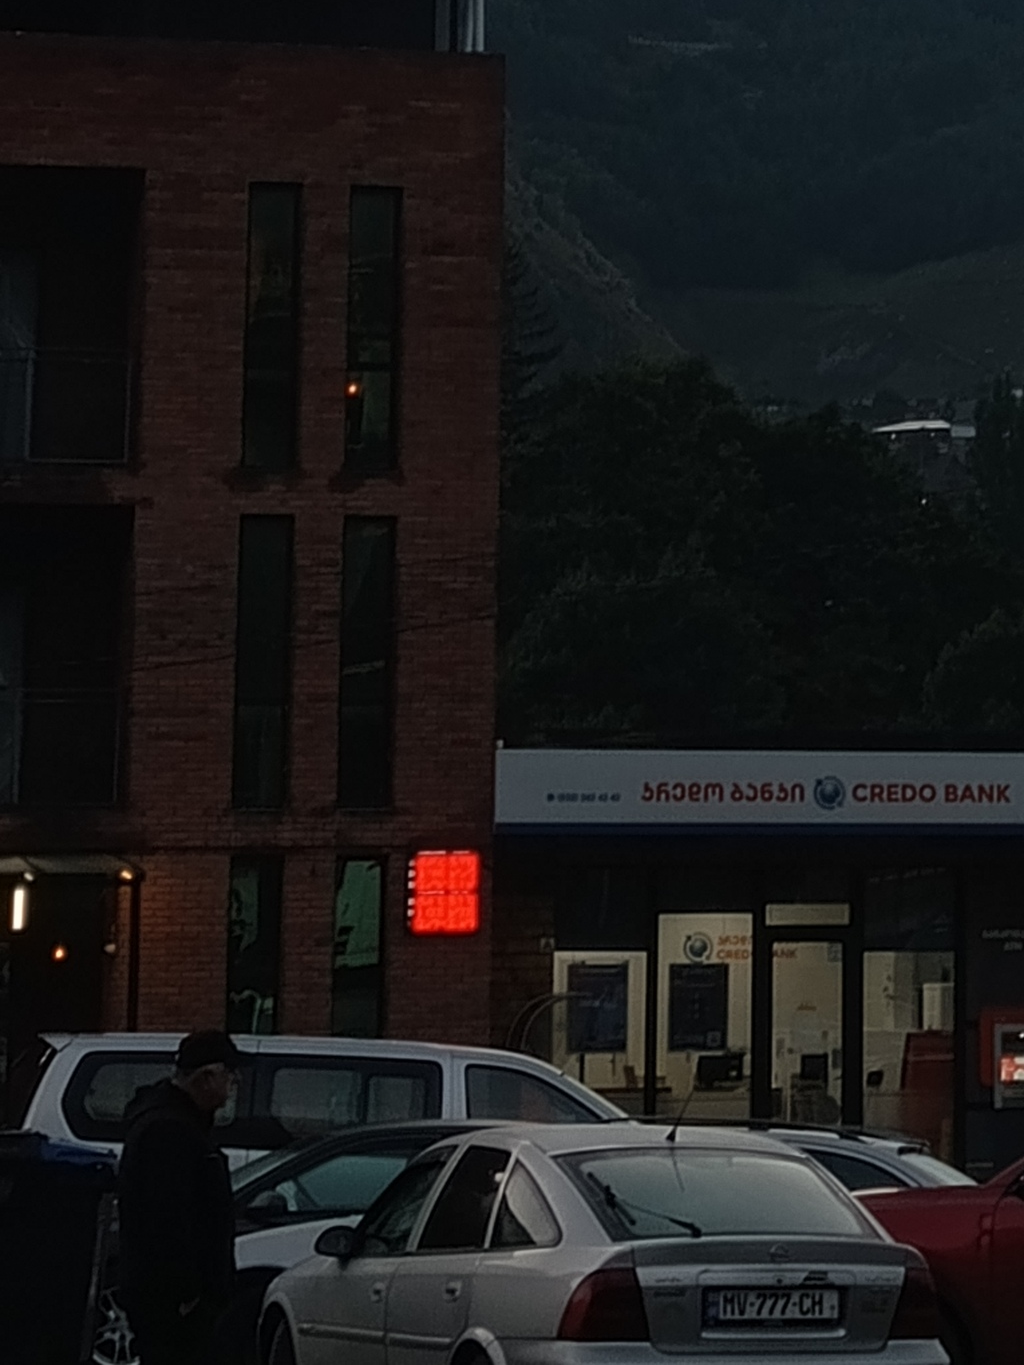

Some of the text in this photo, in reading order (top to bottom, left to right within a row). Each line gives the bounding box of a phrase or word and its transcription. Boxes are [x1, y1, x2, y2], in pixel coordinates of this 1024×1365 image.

[641, 782, 805, 803] კრედო ბანკი
[852, 783, 1011, 804] CREDO BANK
[717, 949, 750, 960] CRED
[722, 1292, 824, 1316] MV-777-CH
